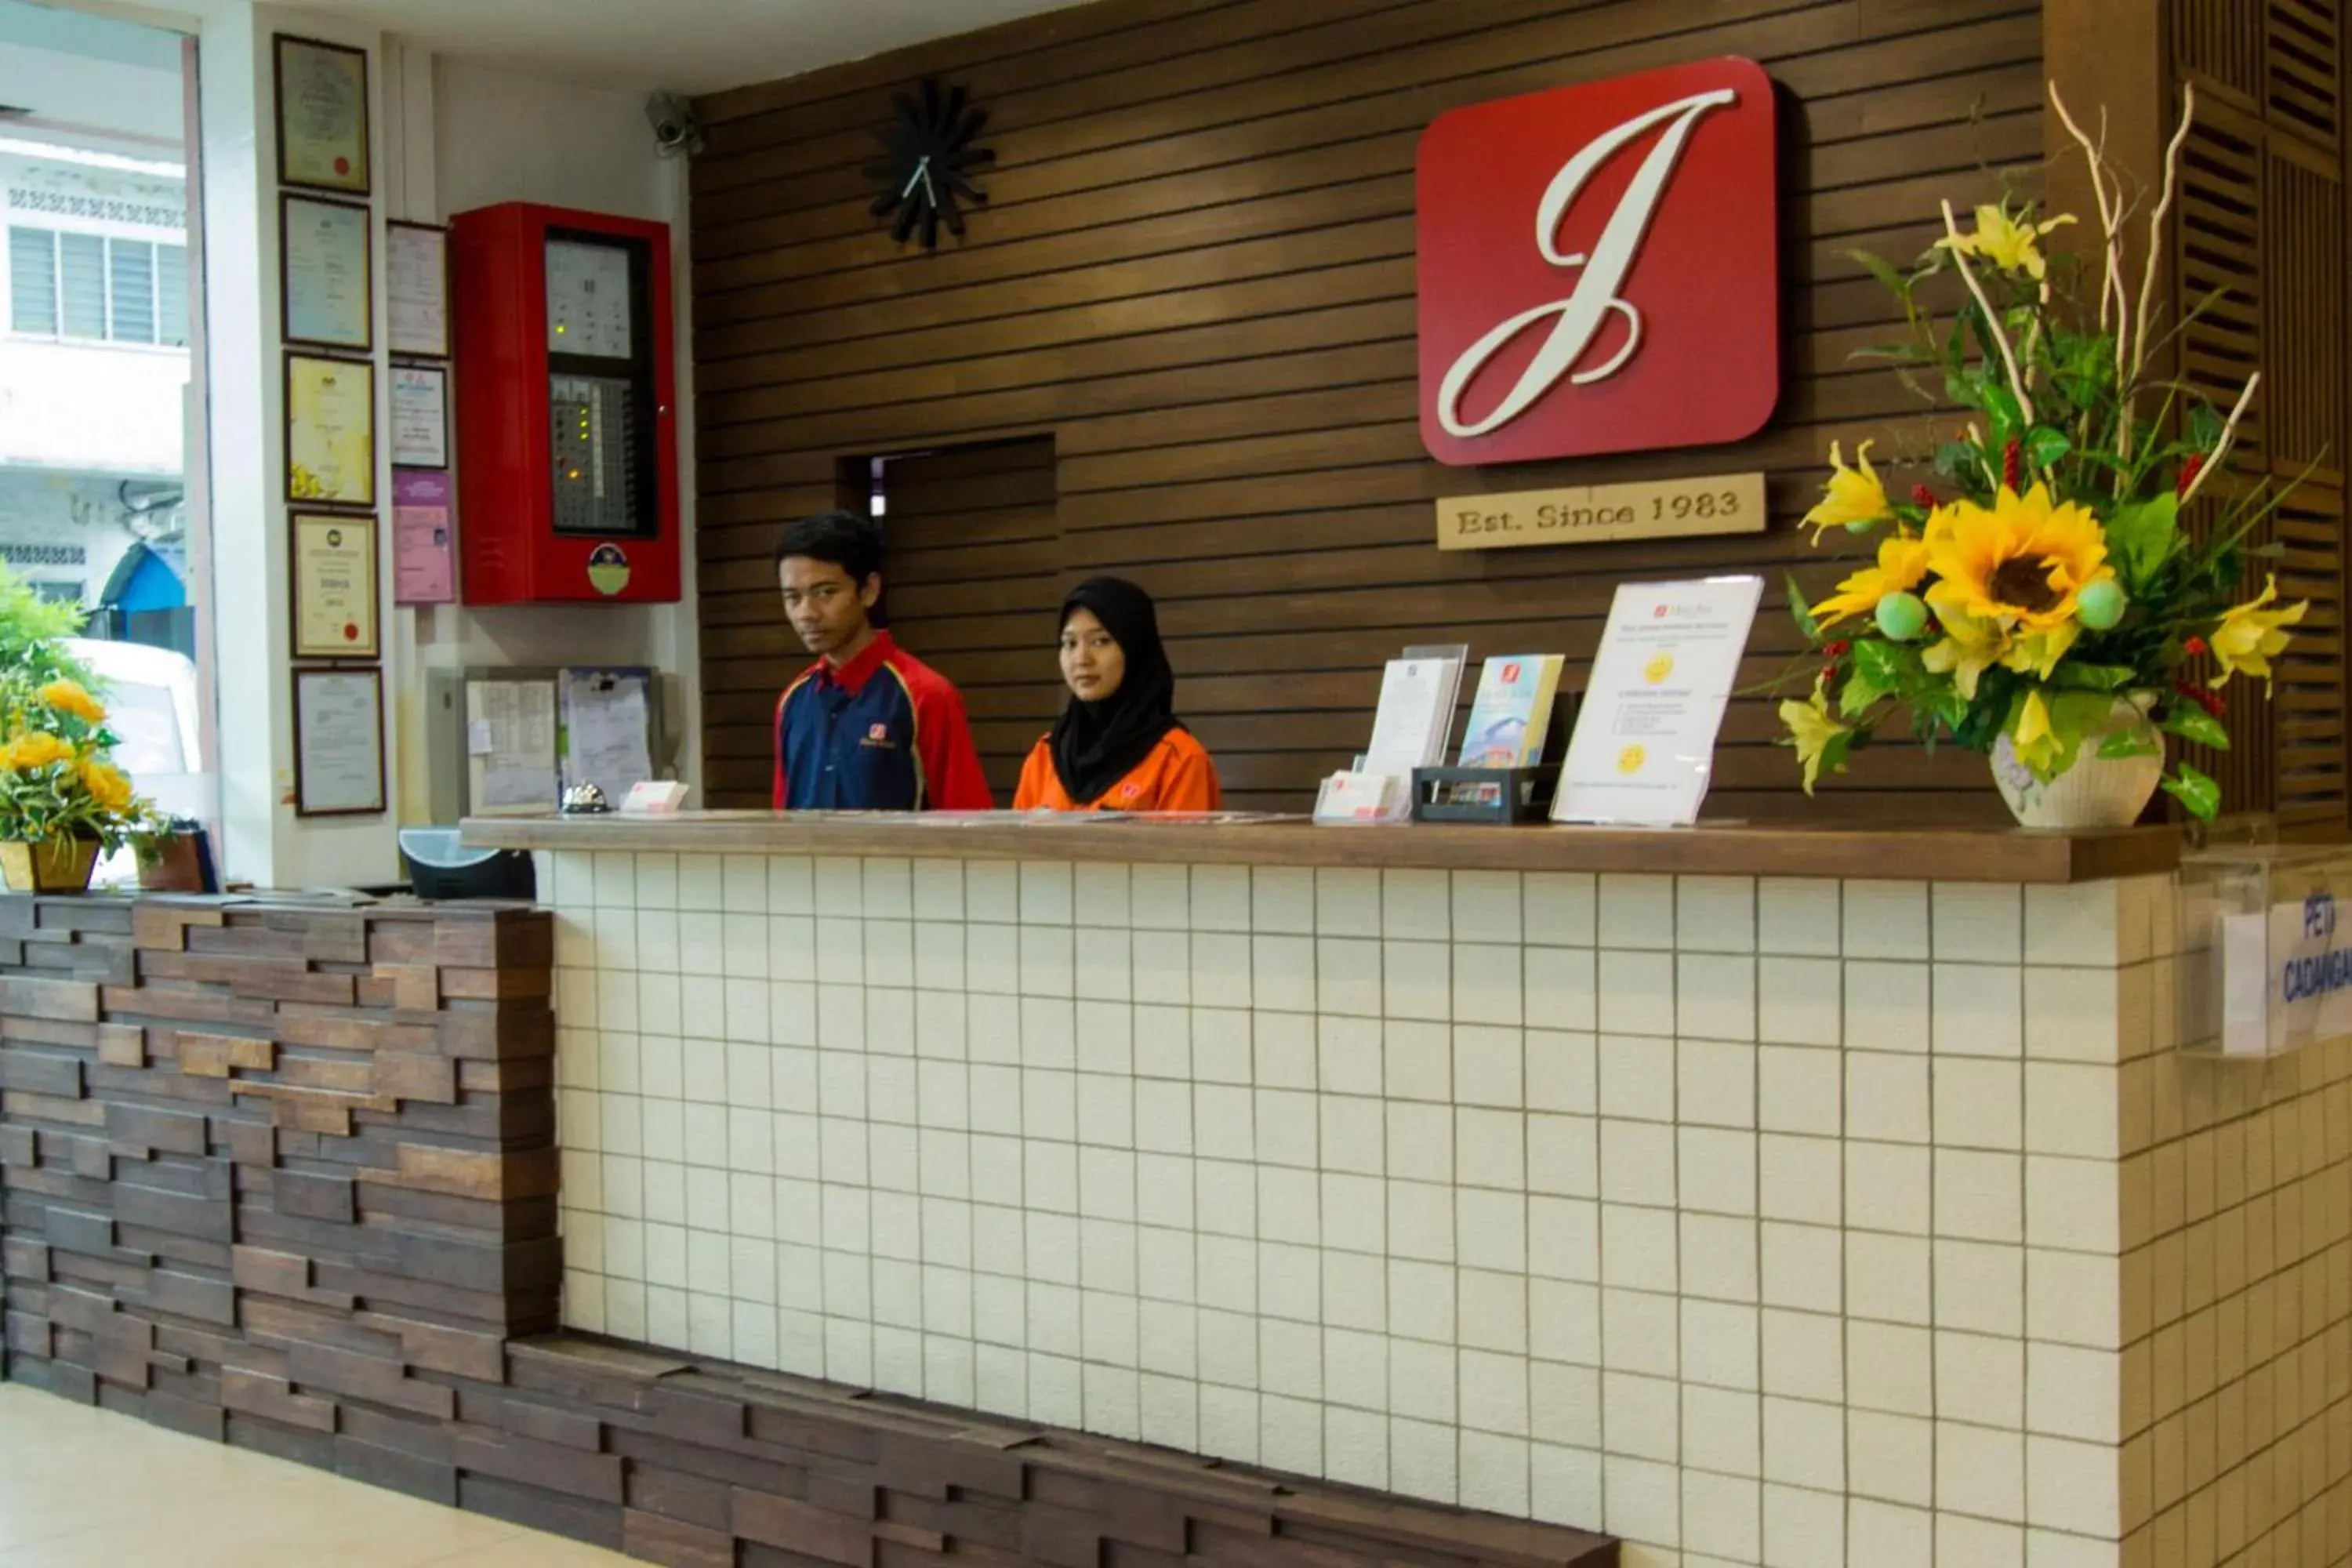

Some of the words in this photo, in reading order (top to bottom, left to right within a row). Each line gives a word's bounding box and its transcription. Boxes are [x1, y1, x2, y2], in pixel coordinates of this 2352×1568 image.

[1438, 89, 1735, 437] J
[1456, 511, 1523, 535] Est.
[1537, 504, 1635, 528] Since
[1652, 490, 1741, 521] 1983
[2283, 946, 2352, 1003] CADANGA
